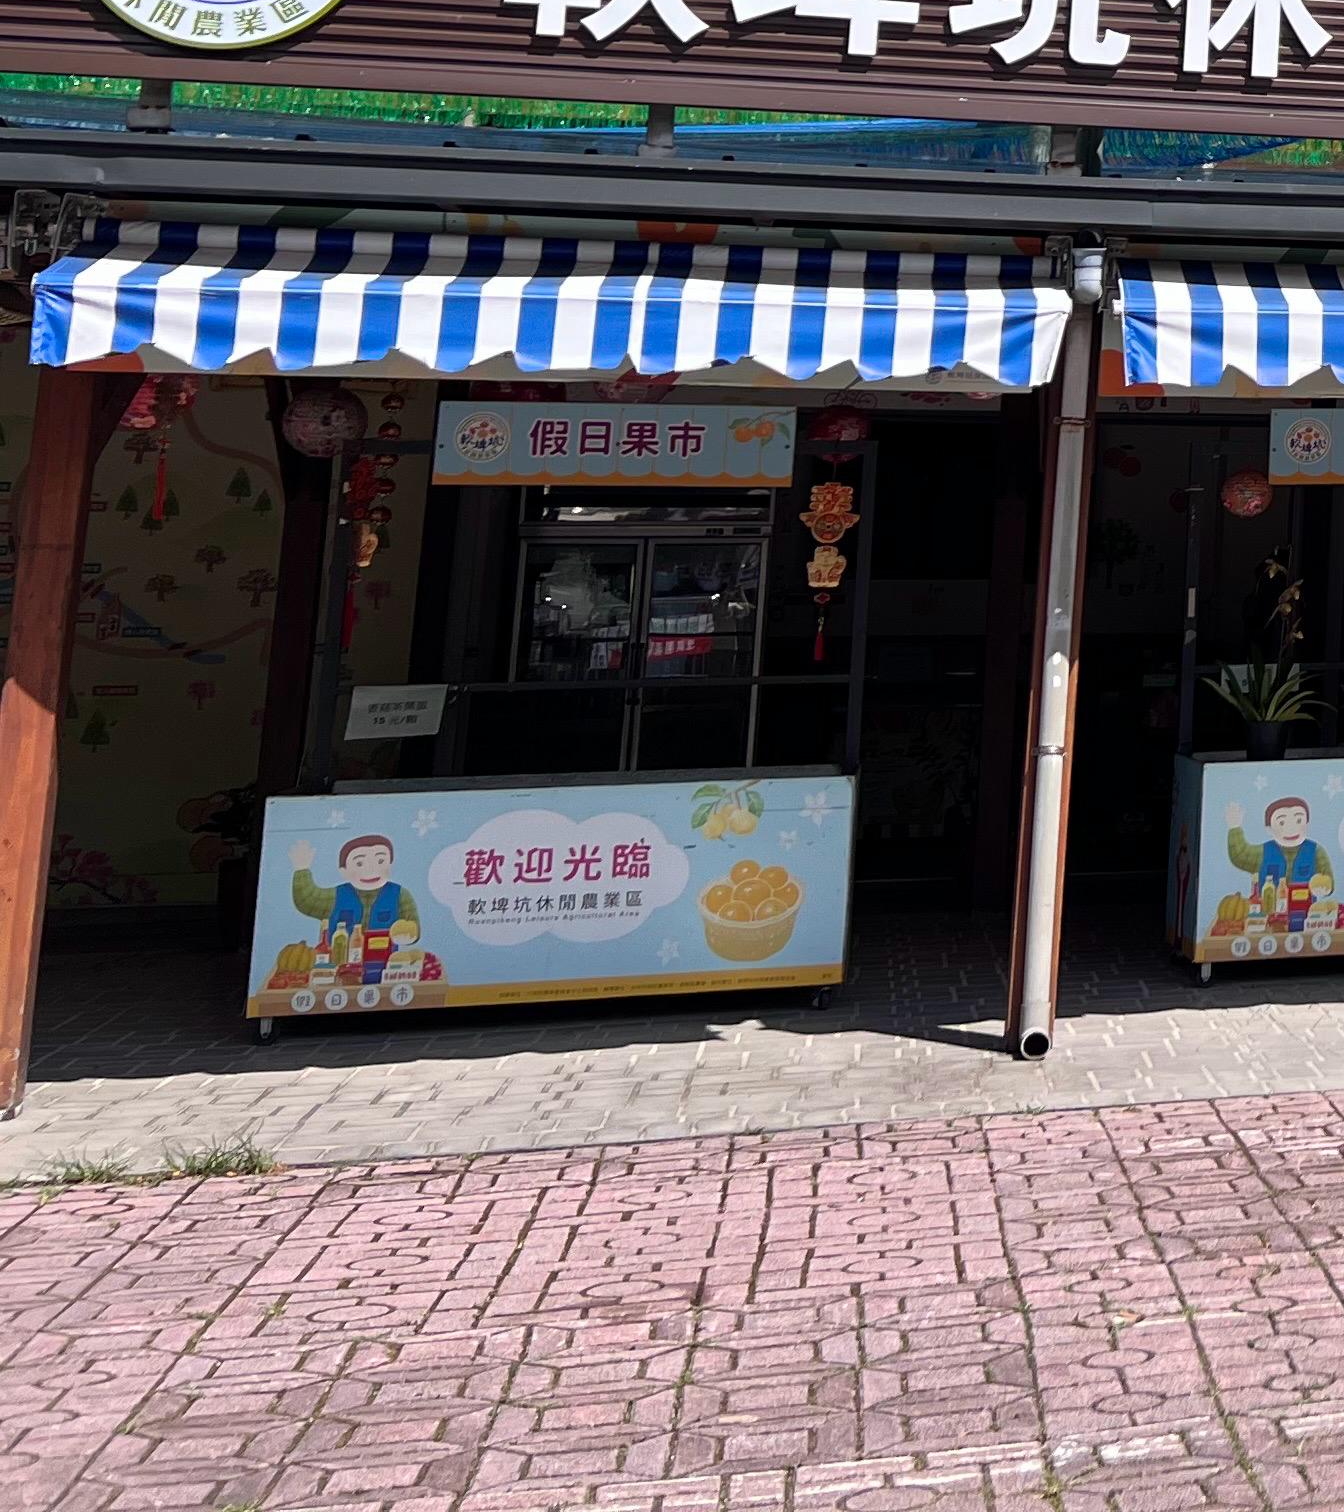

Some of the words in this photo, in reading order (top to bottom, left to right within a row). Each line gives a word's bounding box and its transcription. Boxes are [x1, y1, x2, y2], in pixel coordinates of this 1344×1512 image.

[527, 418, 706, 458] 假日果市
[464, 843, 652, 887] 歡迎光臨
[468, 890, 643, 916] 軟埤坑休閒農業區
